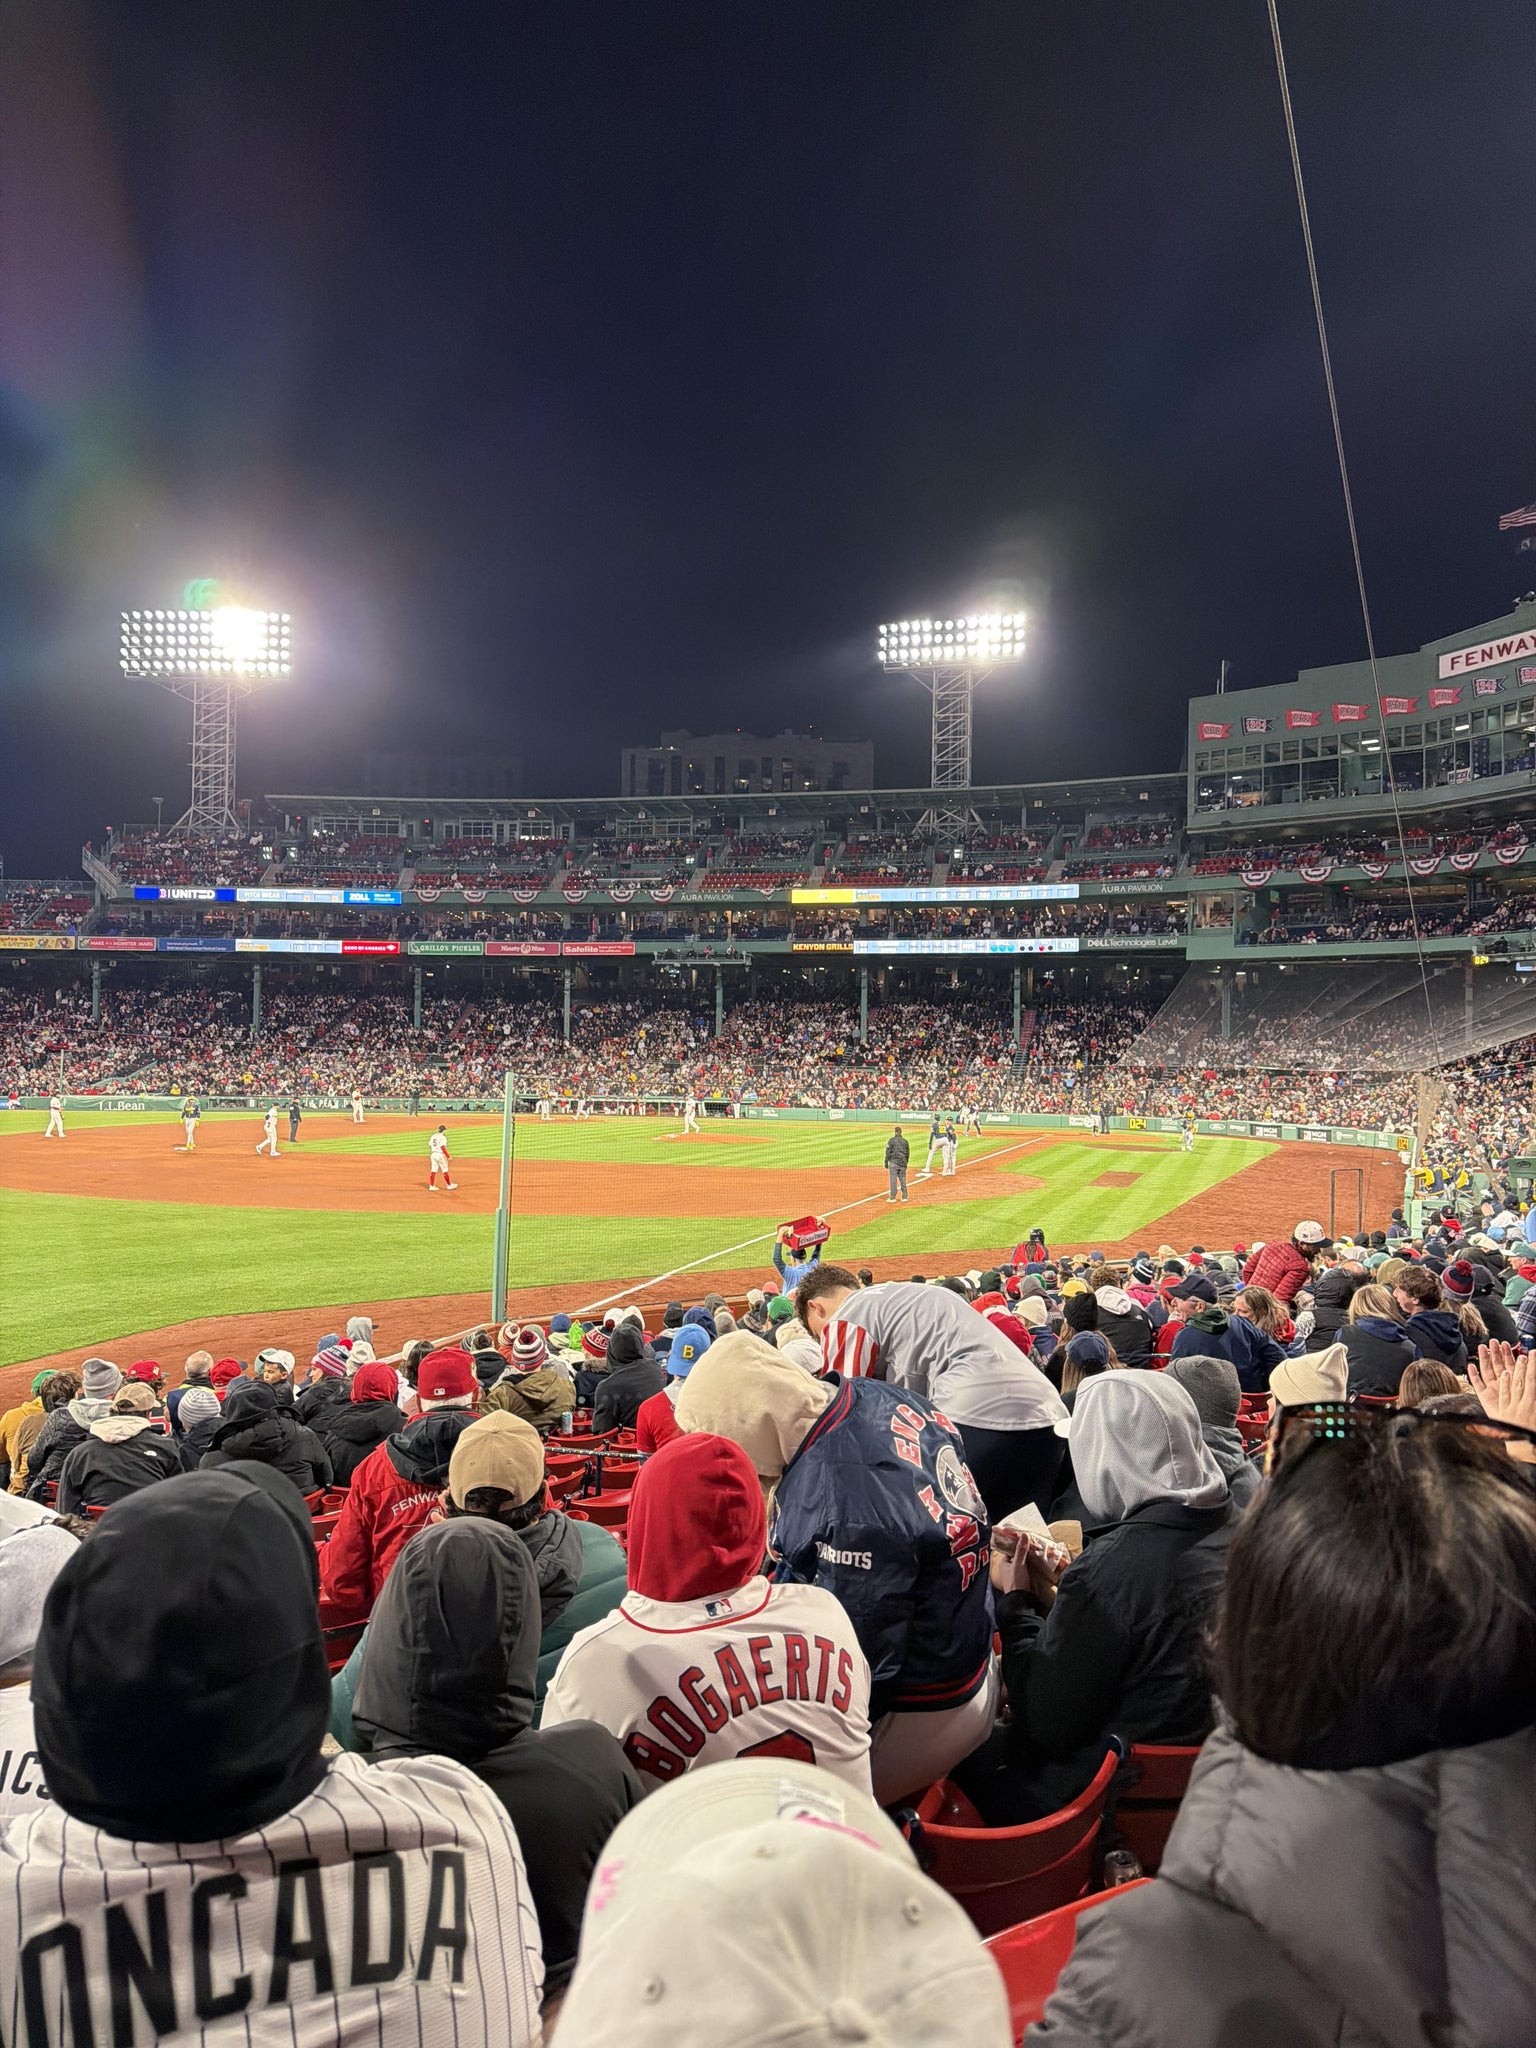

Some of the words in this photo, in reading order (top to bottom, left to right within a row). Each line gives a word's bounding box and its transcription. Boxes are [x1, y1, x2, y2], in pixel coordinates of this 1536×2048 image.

[1127, 883, 1162, 891] PAVILION
[171, 890, 215, 900] UNITED
[349, 893, 369, 901] ZOLL
[704, 893, 734, 901] PAVILION
[793, 943, 825, 951] KENYON
[826, 943, 854, 951] GRILLS
[1109, 939, 1157, 948] Technologies
[1157, 938, 1178, 946] Level
[682, 1344, 695, 1359] B
[624, 1635, 853, 1781] BOGAERTS
[0, 1850, 467, 2048] ONCADA
